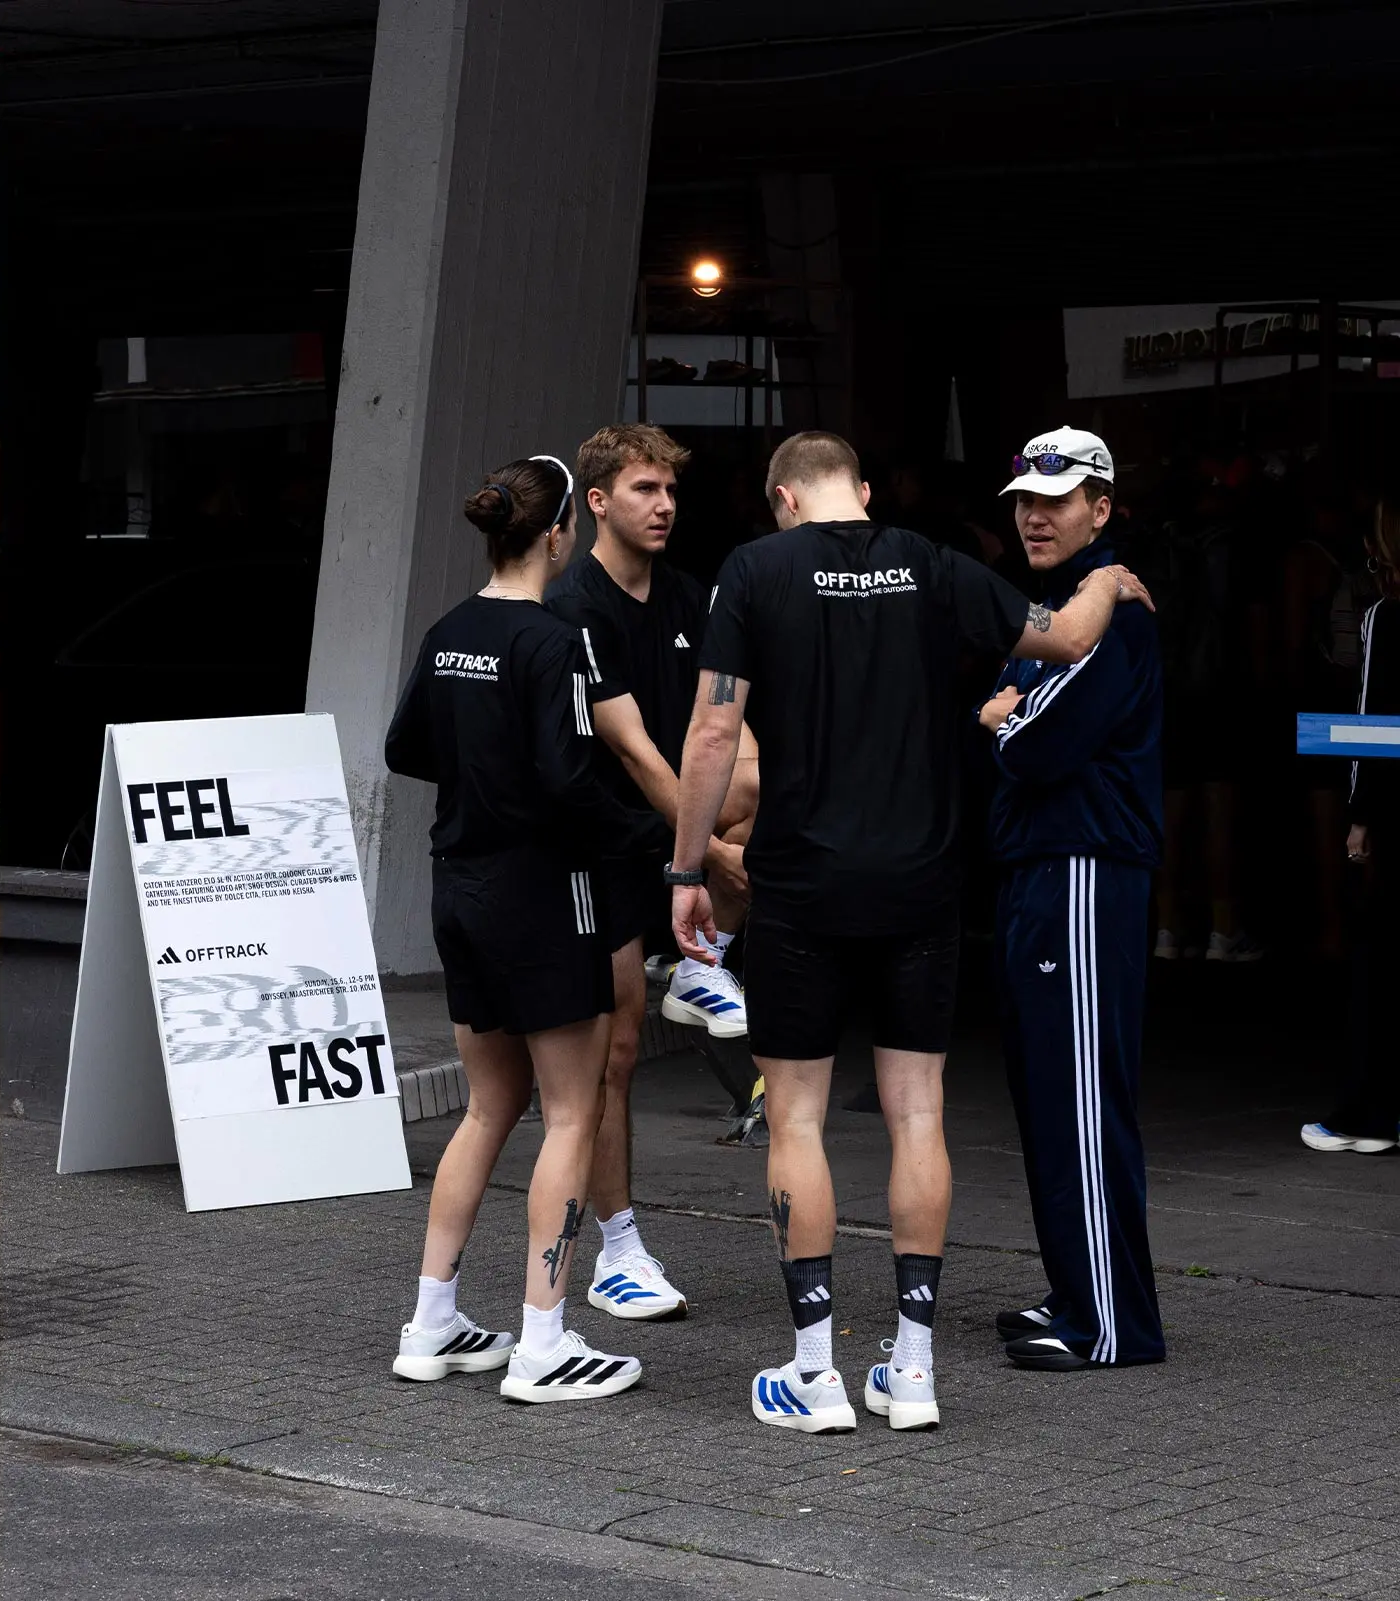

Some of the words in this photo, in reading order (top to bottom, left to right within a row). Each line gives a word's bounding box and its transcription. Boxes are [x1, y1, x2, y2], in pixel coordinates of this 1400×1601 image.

[813, 568, 915, 589] OFFTRACK
[821, 589, 857, 597] COMMUNITY
[858, 590, 870, 598] FOR
[883, 584, 917, 593] OUTDOORS
[127, 777, 250, 843] FEEL
[144, 881, 162, 889] CATCH
[164, 879, 175, 888] THE
[176, 878, 202, 886] ADIZERO
[225, 875, 232, 883] IN
[233, 873, 255, 882] ACTION
[264, 871, 277, 880] OUR
[279, 869, 305, 879] COLOGNE
[307, 867, 333, 876] GALLERY
[181, 886, 214, 895] FEATURING
[215, 884, 233, 893] VIDEO
[248, 881, 264, 890] SHOE
[290, 877, 317, 886] CURATED
[319, 875, 333, 884] SIPS
[334, 875, 339, 883] &
[340, 874, 357, 882] BITES
[147, 899, 159, 907] AND
[160, 898, 171, 906] THE
[173, 896, 193, 905] FINEST
[194, 895, 213, 903] TUNES
[215, 894, 223, 902] BY
[225, 892, 245, 901] DOLCE
[261, 889, 278, 898] FELIX
[279, 888, 291, 896] AND
[185, 942, 269, 963] OFFTRACK
[364, 974, 375, 982] PM
[289, 988, 334, 998] MAASTRICHTER
[267, 1034, 386, 1106] FAST
